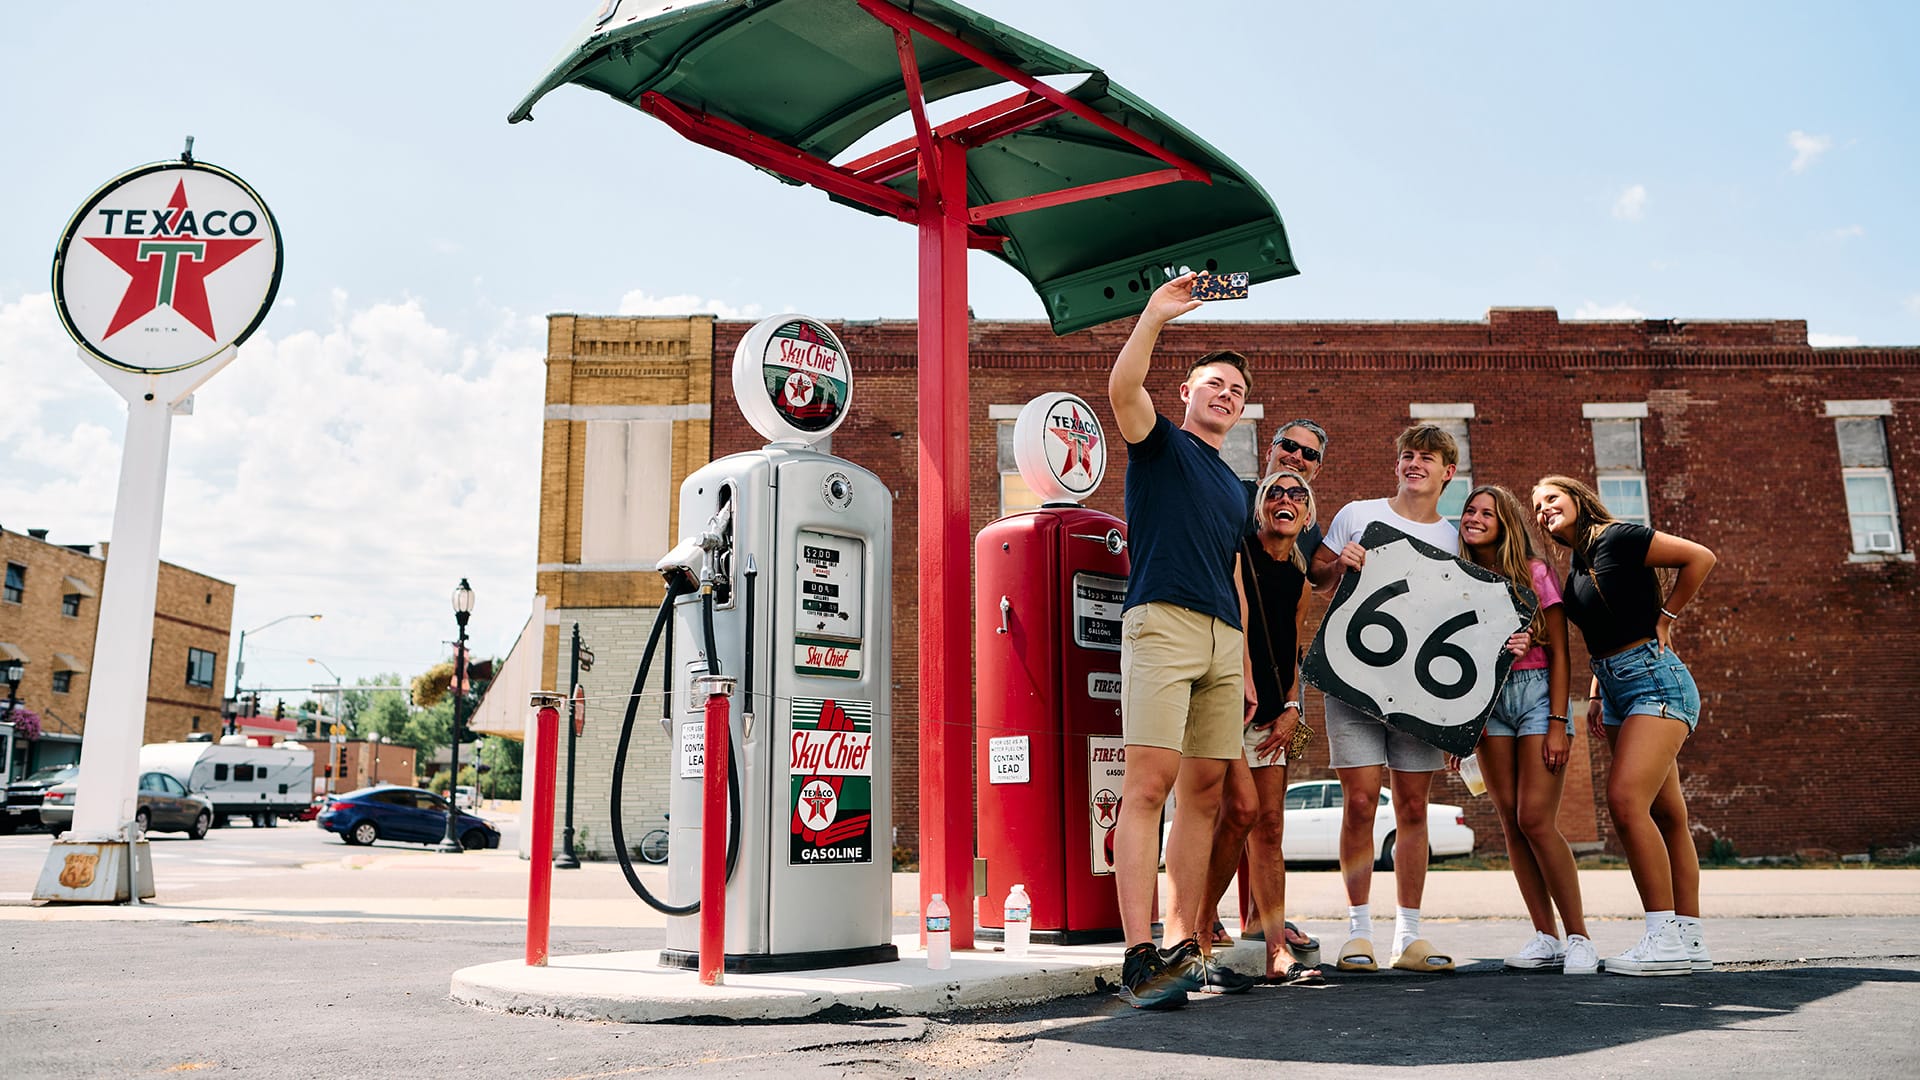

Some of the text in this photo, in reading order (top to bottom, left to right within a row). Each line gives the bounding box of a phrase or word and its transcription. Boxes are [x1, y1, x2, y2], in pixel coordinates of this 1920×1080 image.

[99, 209, 258, 237] TEXACO
[781, 339, 837, 373] Sky Chief
[1052, 416, 1097, 435] TEXACO
[1087, 627, 1111, 637] GALLONS
[1346, 578, 1479, 700] 66
[806, 646, 849, 668] Sky Chief
[688, 755, 704, 766] LEA
[791, 731, 872, 776] Sky Chief
[993, 754, 1024, 763] CONTAINS
[998, 764, 1019, 773] LEAD
[803, 789, 833, 798] TEXACO
[801, 847, 863, 860] GASOLINE
